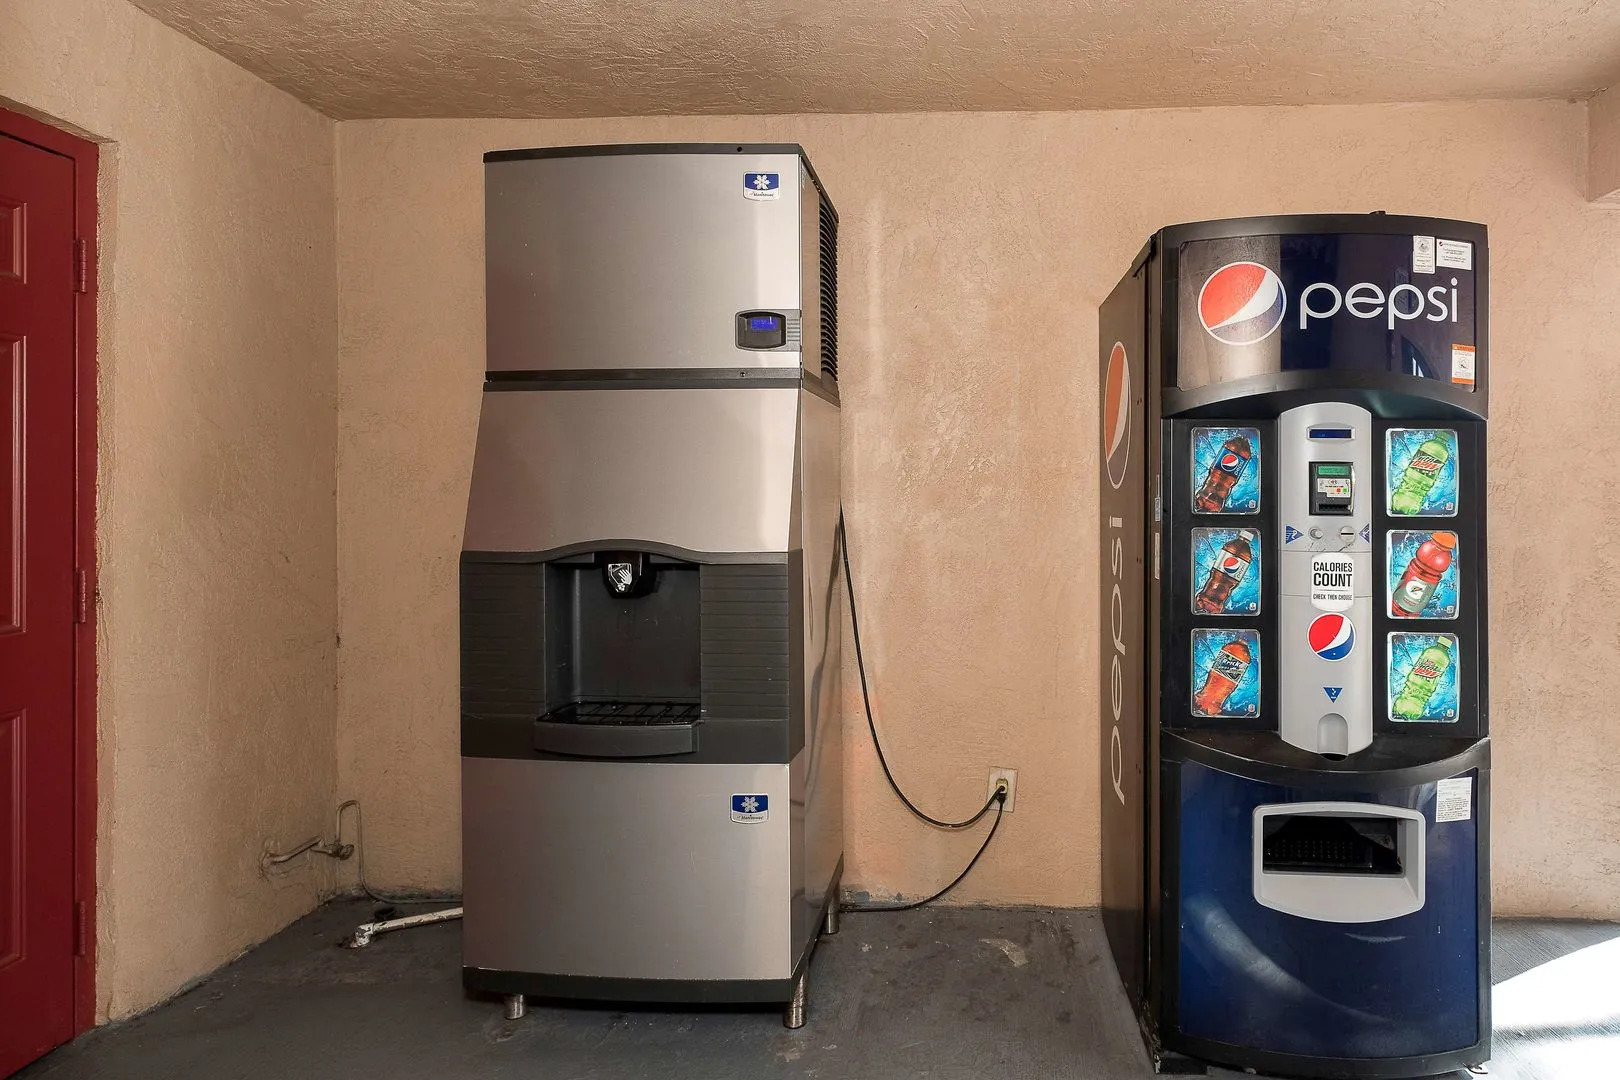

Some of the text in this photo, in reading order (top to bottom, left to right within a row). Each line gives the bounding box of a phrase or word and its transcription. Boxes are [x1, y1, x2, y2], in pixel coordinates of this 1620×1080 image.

[1300, 277, 1458, 330] pepsi
[1313, 561, 1353, 573] CALORIES
[1313, 572, 1353, 587] COUNT
[1327, 593, 1338, 601] THEN
[1109, 516, 1126, 806] pepsi
